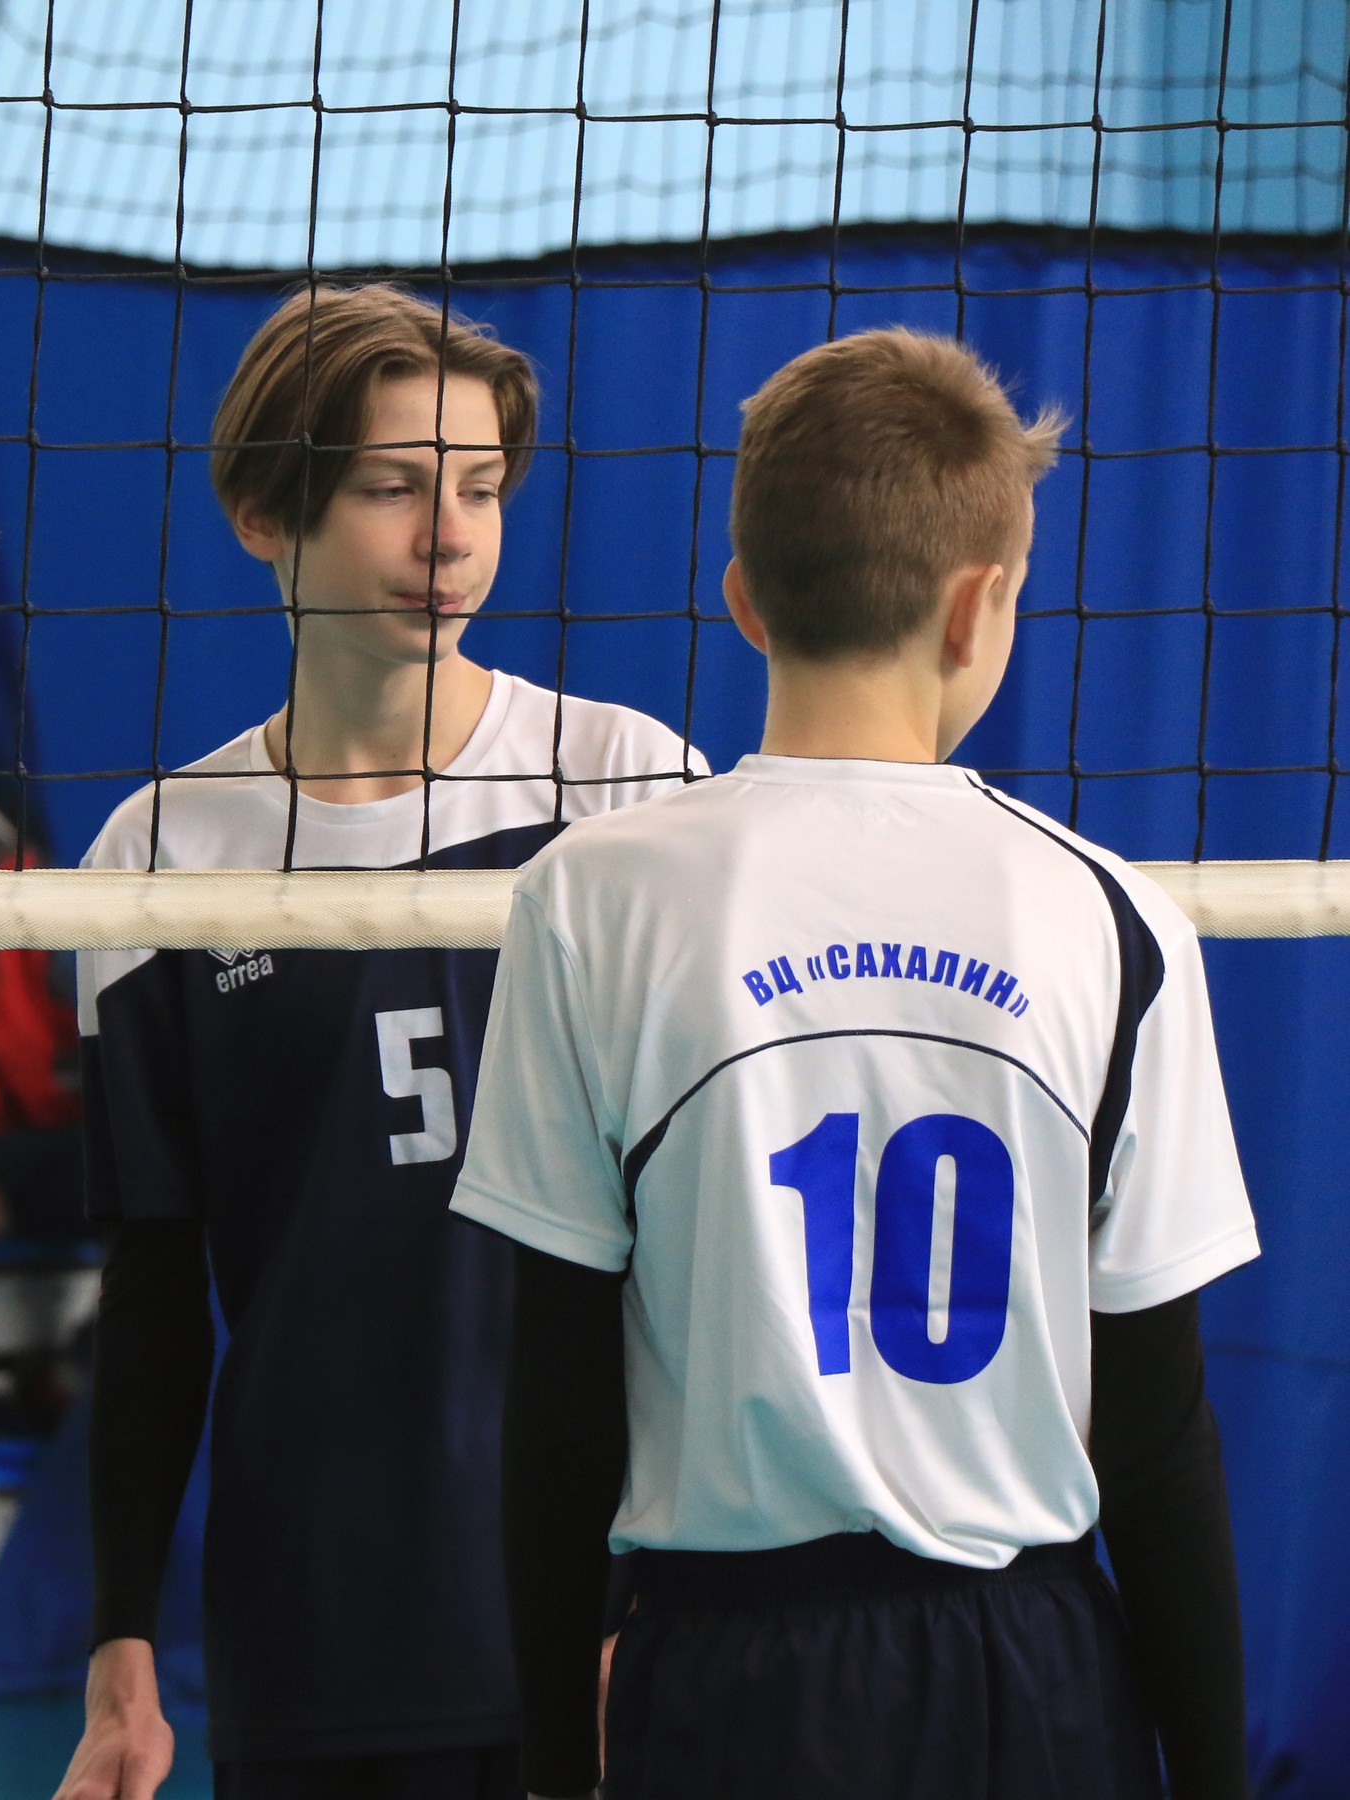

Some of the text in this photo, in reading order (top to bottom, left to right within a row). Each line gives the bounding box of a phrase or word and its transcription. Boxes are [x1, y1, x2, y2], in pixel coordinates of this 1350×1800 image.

[742, 955, 803, 1007] ВЦ
[375, 1006, 457, 1165] 5
[769, 1112, 1014, 1385] 10
